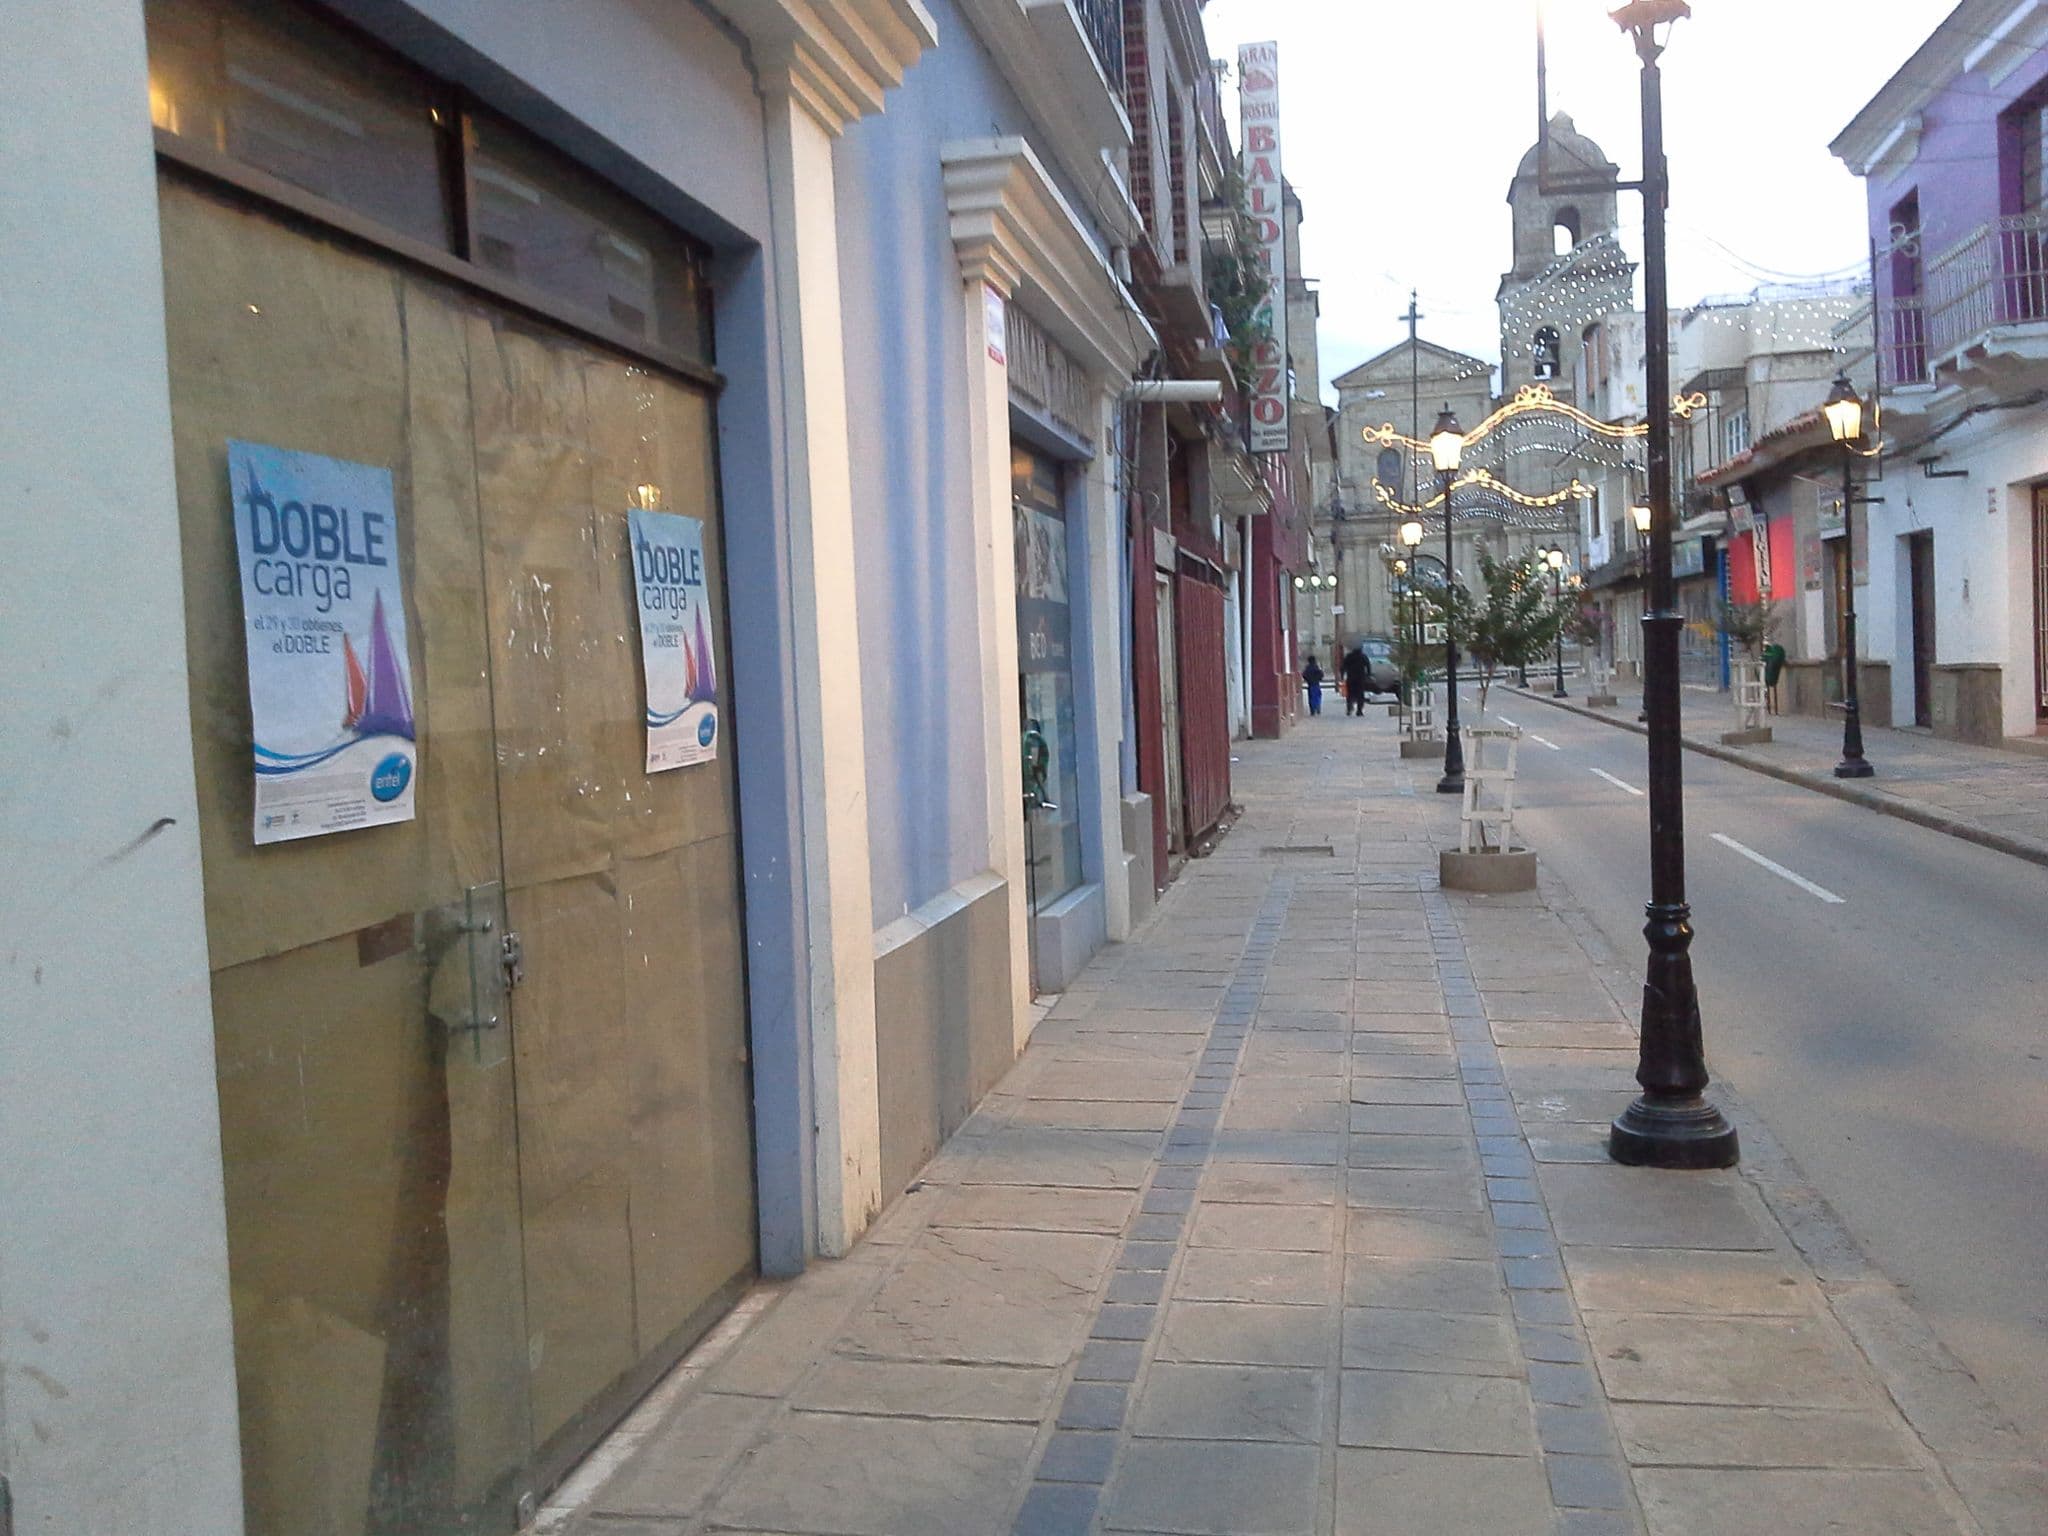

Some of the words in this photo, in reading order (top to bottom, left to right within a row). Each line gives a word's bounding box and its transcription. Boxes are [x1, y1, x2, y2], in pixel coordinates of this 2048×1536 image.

[1248, 125, 1284, 425] BALDIEZO
[247, 489, 388, 567] DOBLE
[253, 558, 353, 613] carga
[637, 540, 702, 587] DOBLE
[642, 584, 688, 620] carga
[285, 634, 331, 654] DOBLE
